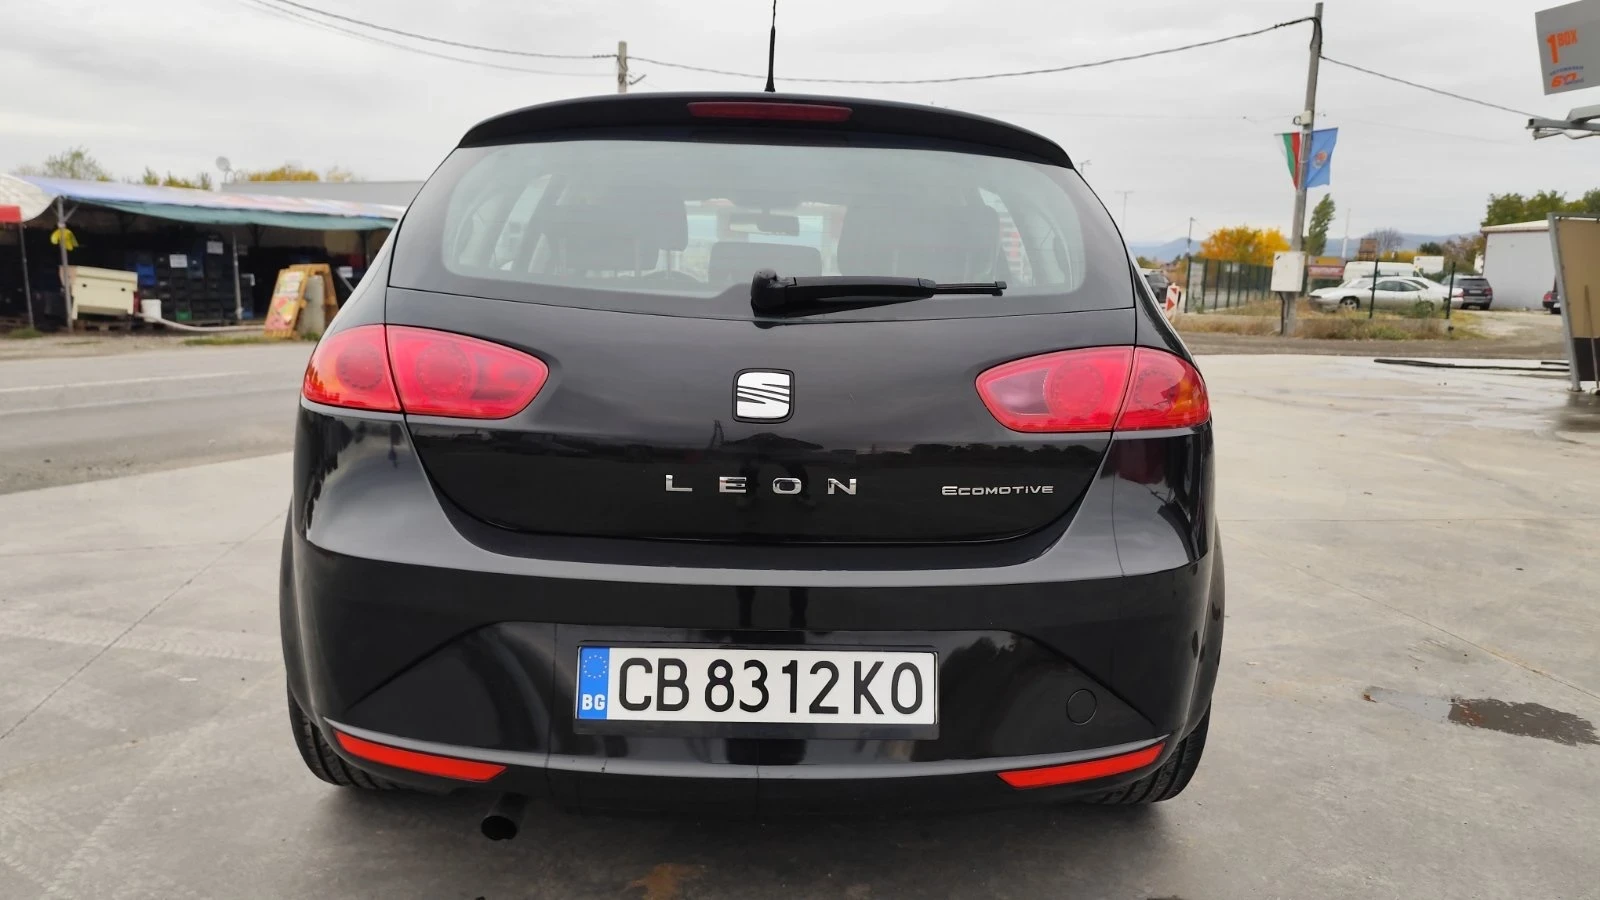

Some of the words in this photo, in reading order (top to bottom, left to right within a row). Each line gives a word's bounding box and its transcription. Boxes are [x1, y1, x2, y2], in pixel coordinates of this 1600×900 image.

[1546, 34, 1559, 64] 1
[665, 474, 857, 495] LEON
[618, 657, 690, 712] CB
[704, 658, 839, 714] 8312
[581, 693, 606, 711] BG
